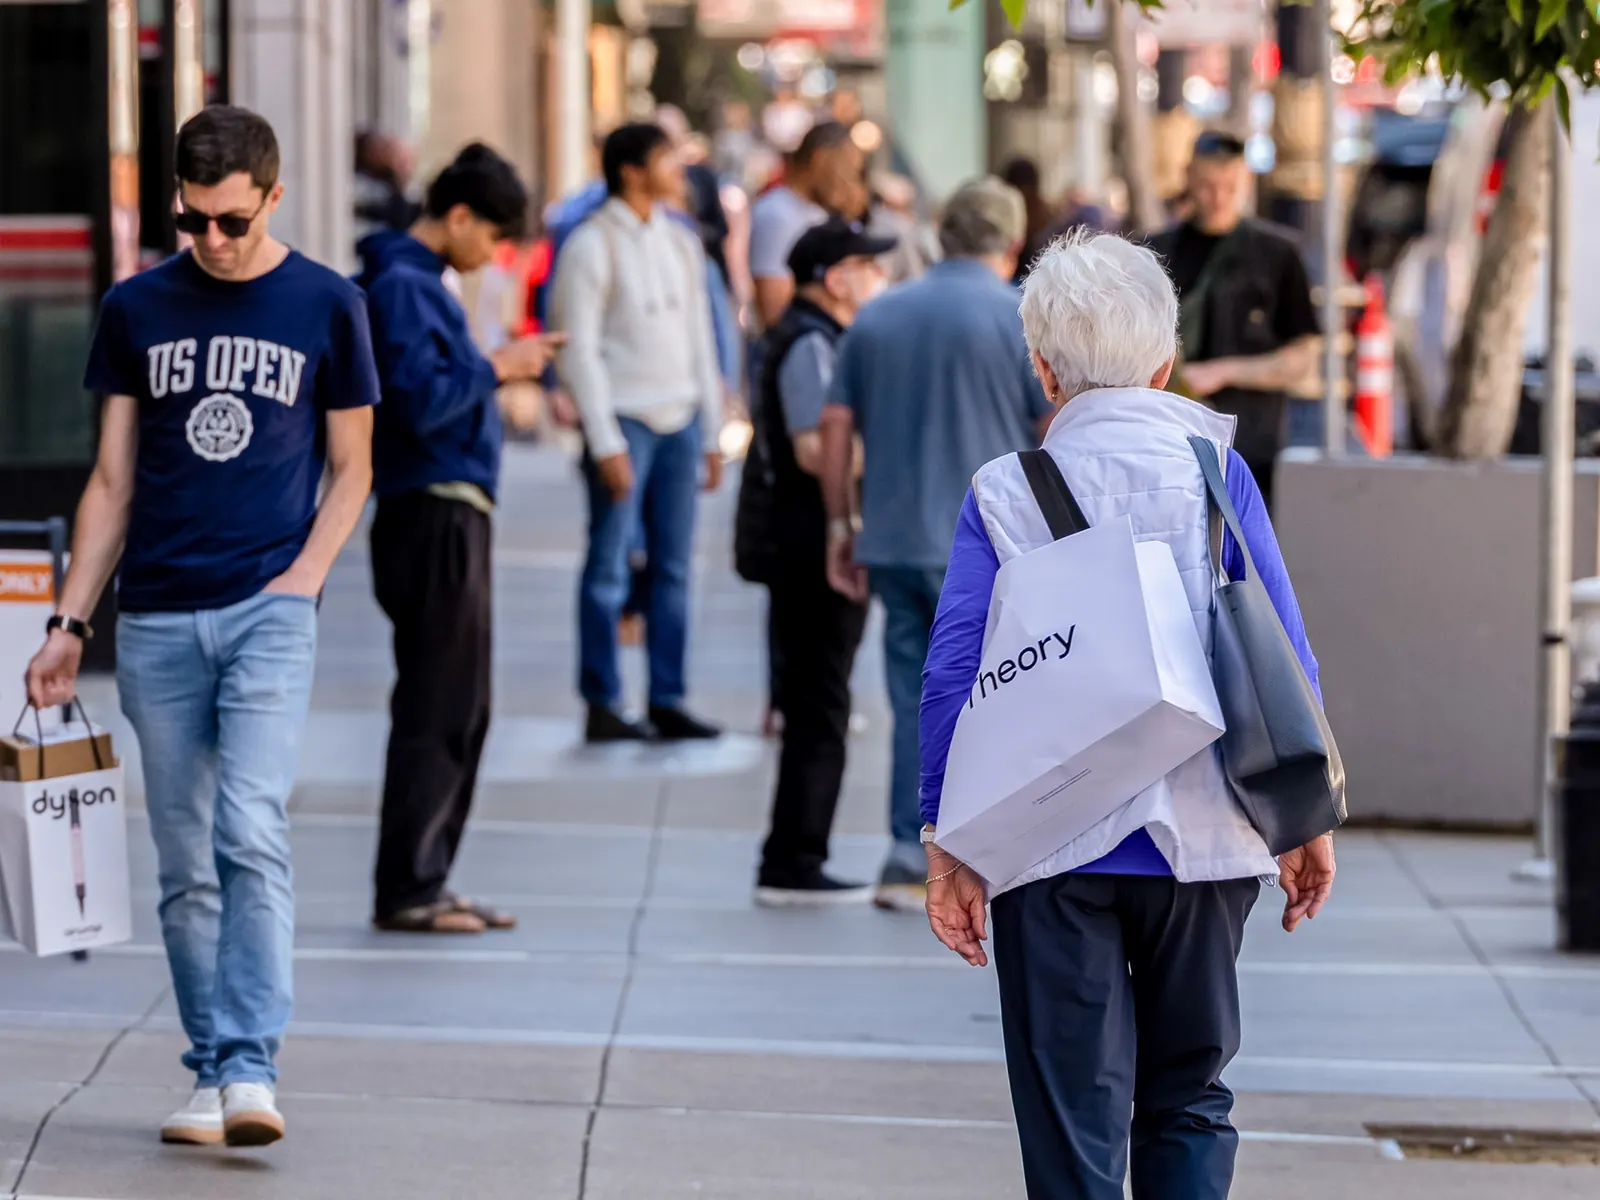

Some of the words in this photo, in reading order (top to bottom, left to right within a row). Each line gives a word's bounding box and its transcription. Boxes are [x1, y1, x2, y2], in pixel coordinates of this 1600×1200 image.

[147, 337, 198, 399] US
[206, 335, 306, 407] OPEN
[32, 786, 116, 820] dyon
